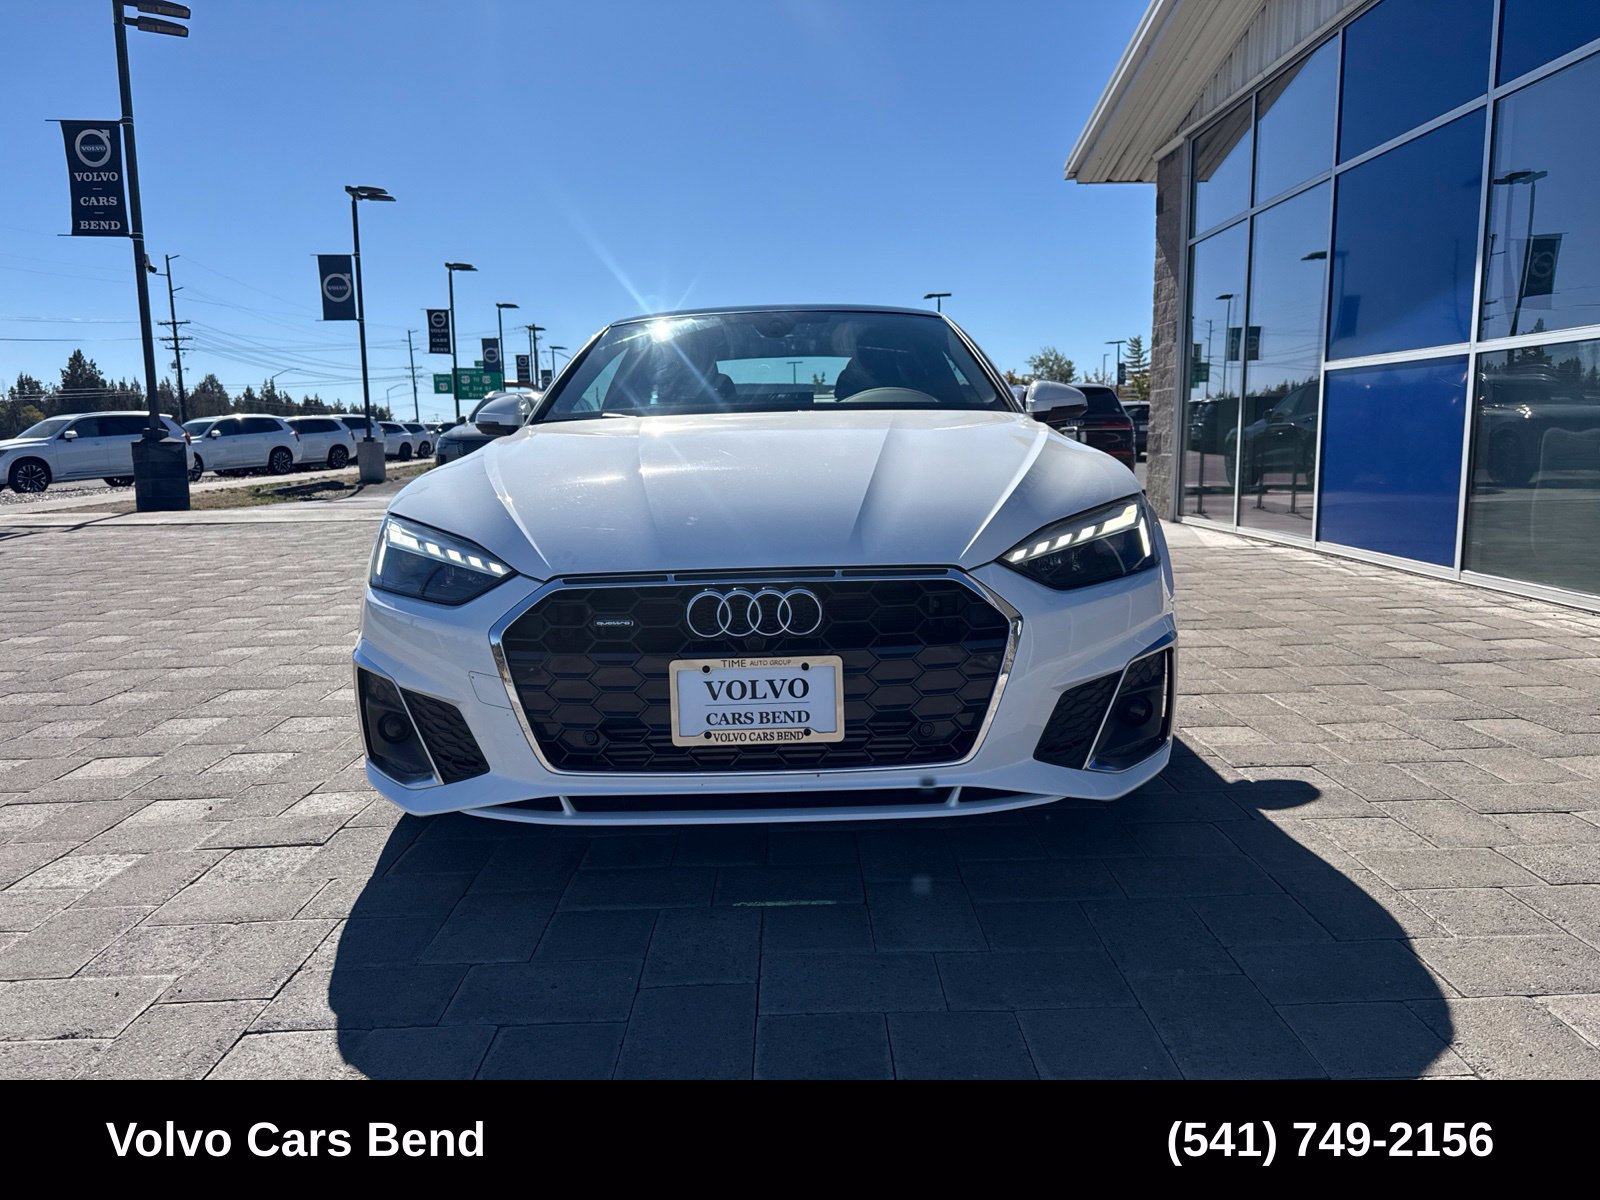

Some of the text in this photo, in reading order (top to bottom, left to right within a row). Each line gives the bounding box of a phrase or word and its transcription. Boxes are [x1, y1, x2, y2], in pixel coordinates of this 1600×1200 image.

[74, 172, 119, 182] VOLVO
[80, 197, 118, 206] CARS
[80, 221, 121, 230] BEND
[720, 659, 747, 668] TIME
[703, 678, 810, 701] VOLVO
[706, 710, 811, 726] CARS BEND
[713, 731, 804, 742] VOLVO CARS BEND
